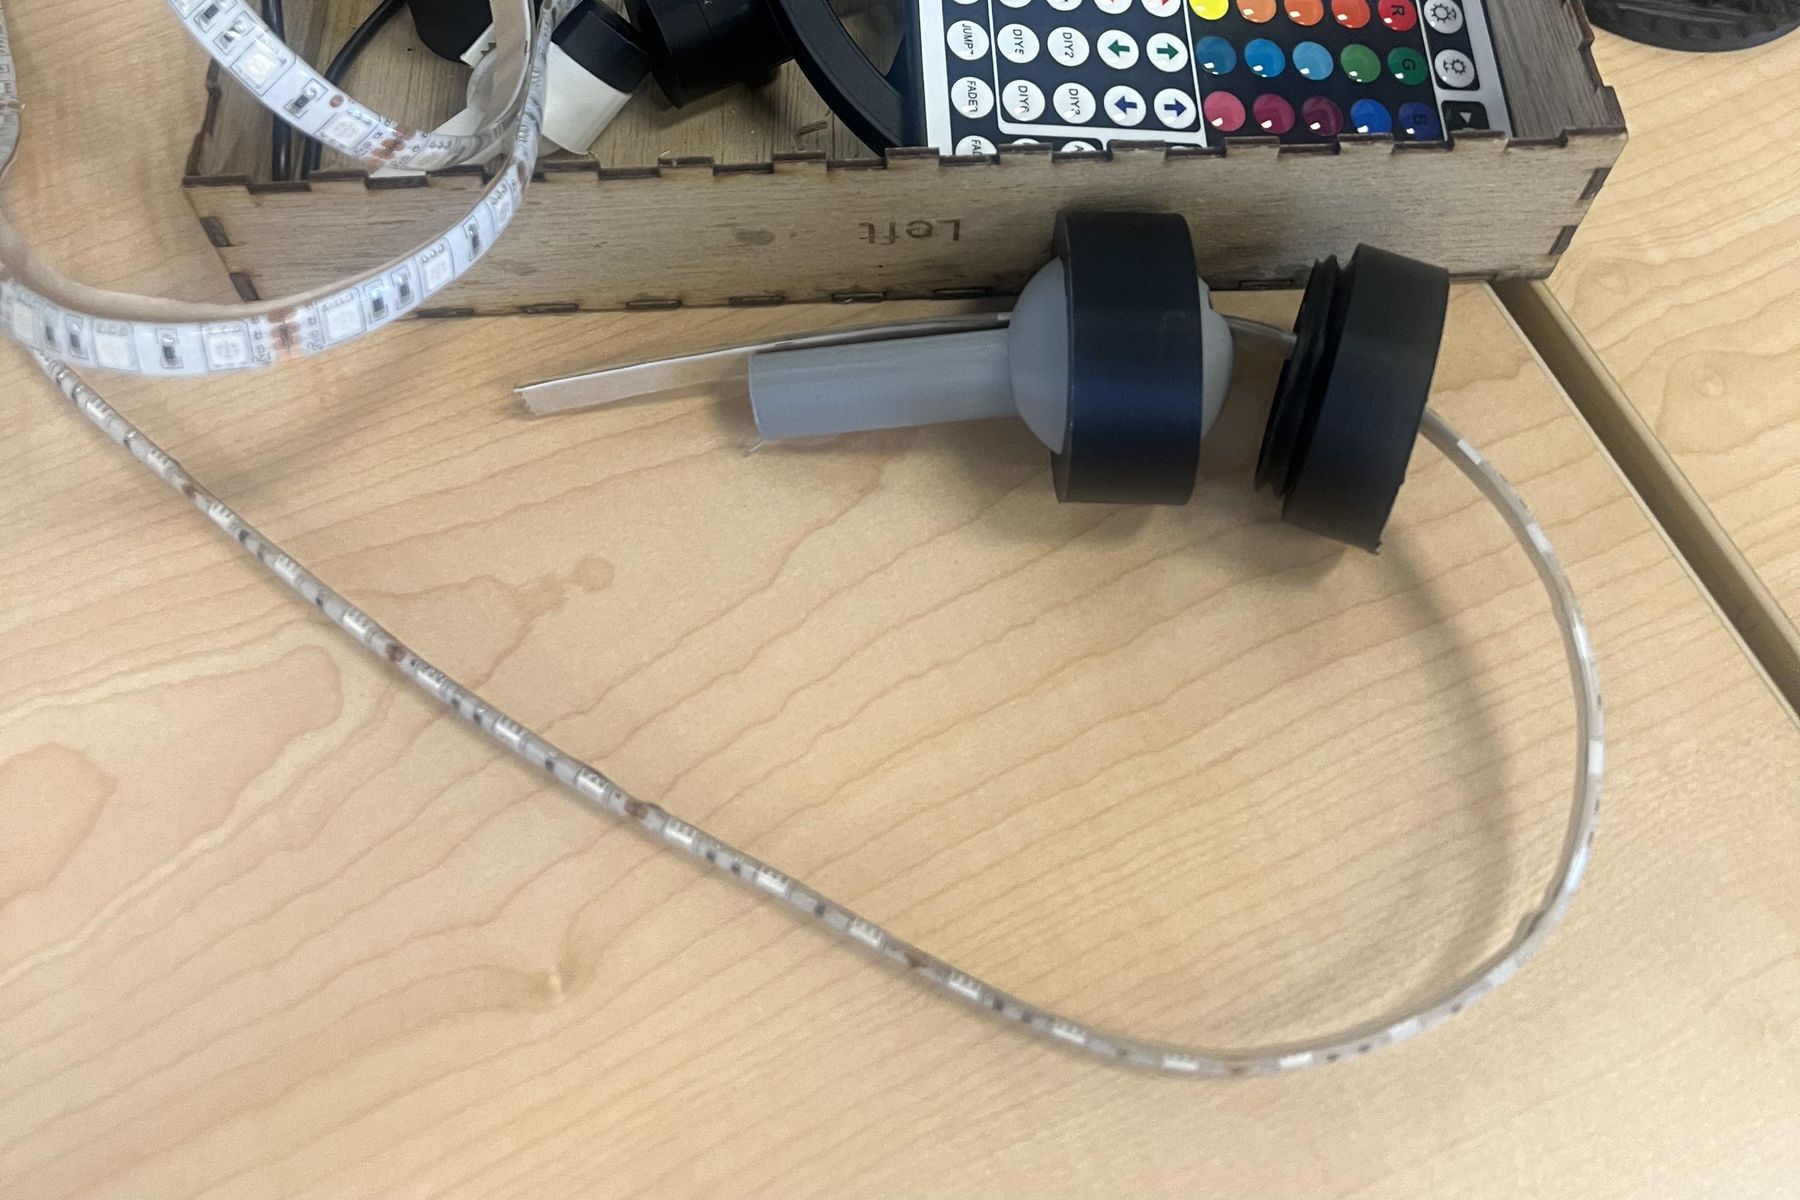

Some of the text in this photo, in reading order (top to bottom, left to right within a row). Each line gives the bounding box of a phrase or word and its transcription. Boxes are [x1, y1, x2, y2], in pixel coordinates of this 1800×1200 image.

[1390, 4, 1405, 16] R
[1062, 32, 1075, 59] DIY2
[1401, 58, 1416, 71] G
[858, 218, 961, 245] Left
